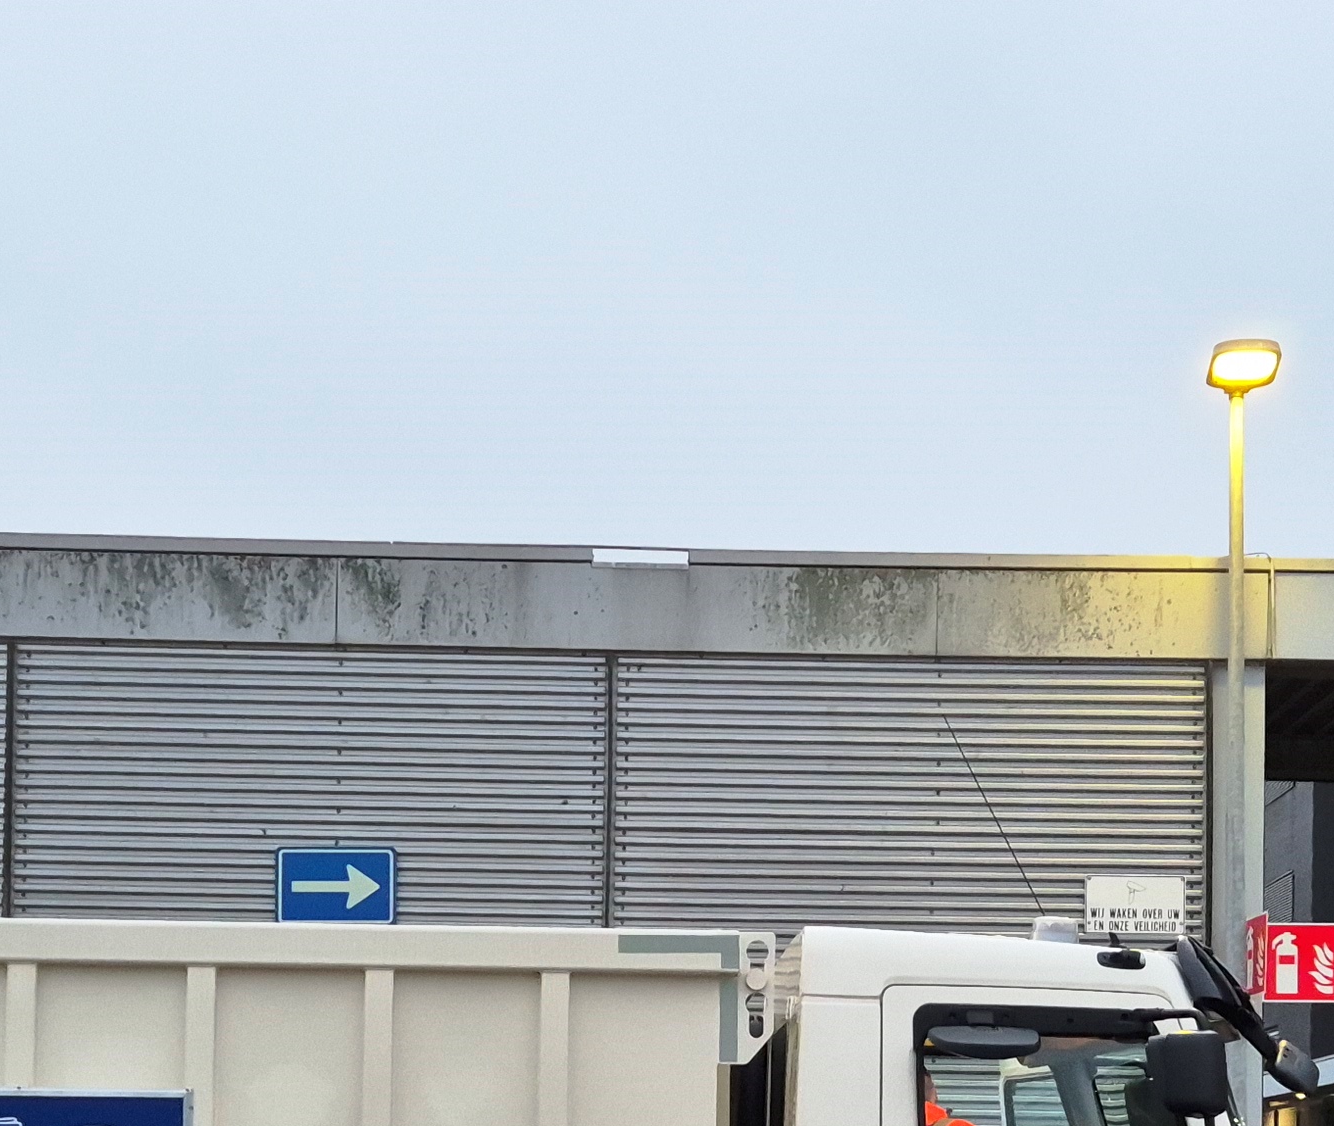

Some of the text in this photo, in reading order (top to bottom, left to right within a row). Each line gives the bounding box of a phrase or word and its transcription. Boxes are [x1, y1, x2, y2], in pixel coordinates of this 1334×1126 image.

[1090, 907, 1180, 919] WIJ WAKEN OVER UW
[1093, 920, 1177, 932] EN ONZE VEILIGHEID
